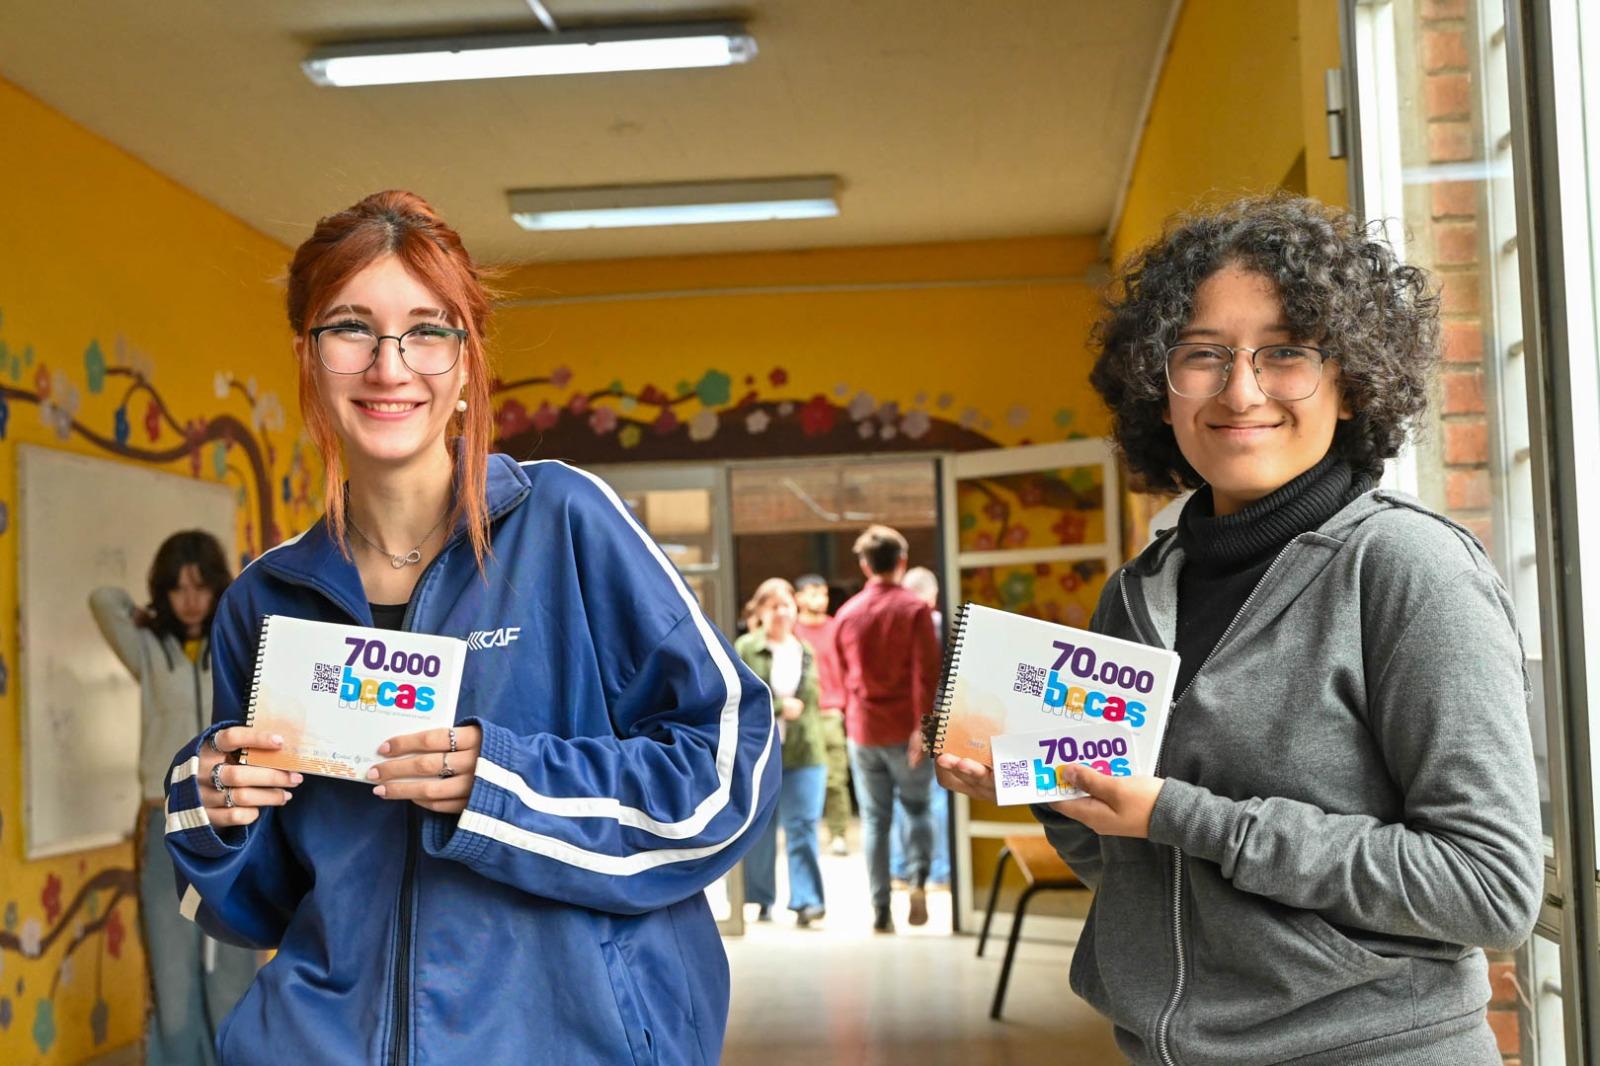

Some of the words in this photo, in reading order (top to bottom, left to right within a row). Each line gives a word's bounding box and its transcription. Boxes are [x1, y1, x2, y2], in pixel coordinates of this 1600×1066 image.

[345, 637, 441, 677] 70.000
[478, 627, 521, 648] CAF
[1052, 640, 1155, 694] 70.000
[339, 666, 435, 712] becas
[1043, 670, 1147, 728] becas
[1039, 736, 1128, 764] 70.000
